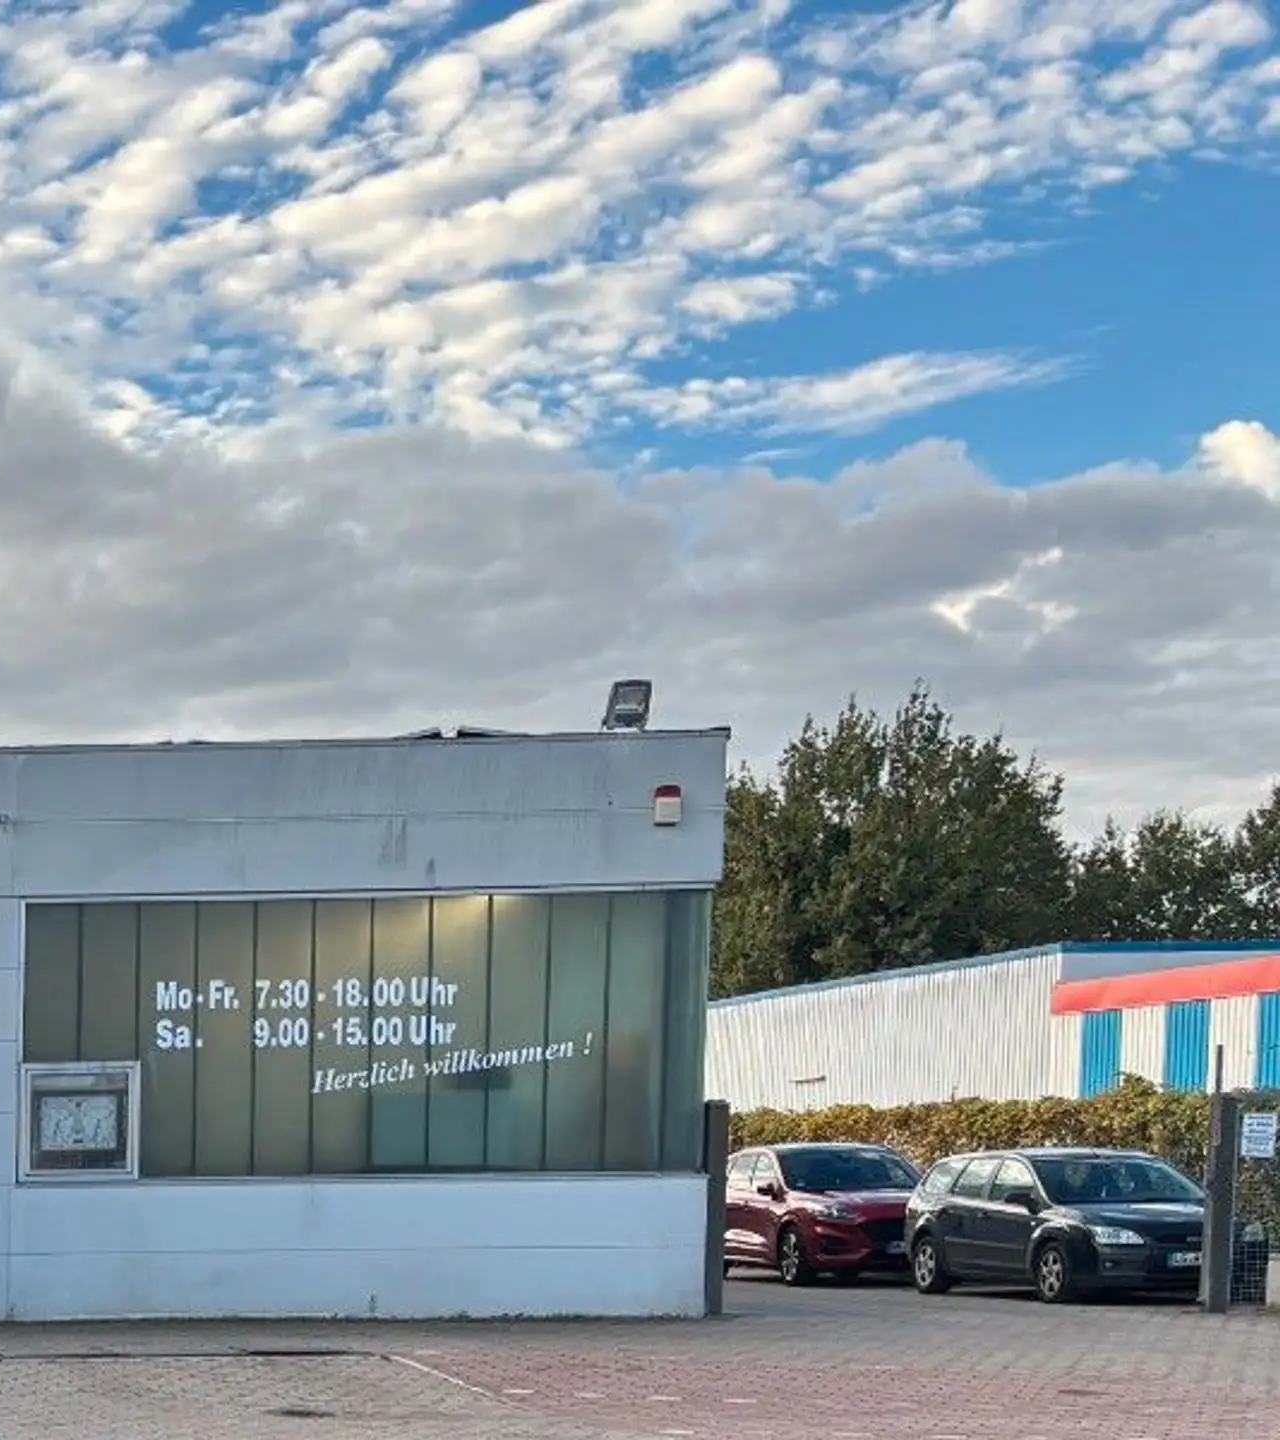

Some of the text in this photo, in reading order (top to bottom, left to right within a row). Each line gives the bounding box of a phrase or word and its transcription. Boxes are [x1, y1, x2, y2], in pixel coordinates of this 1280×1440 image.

[253, 978, 310, 1010] 7.30
[331, 976, 406, 1007] 18.00
[409, 975, 459, 1007] Uhr
[155, 1018, 204, 1049] Sa.
[253, 1016, 310, 1048] 9.00
[331, 1015, 403, 1047] 15.00
[408, 1014, 457, 1046] Uhr
[311, 1058, 415, 1094] Herzlich
[422, 1040, 574, 1077] willkommen
